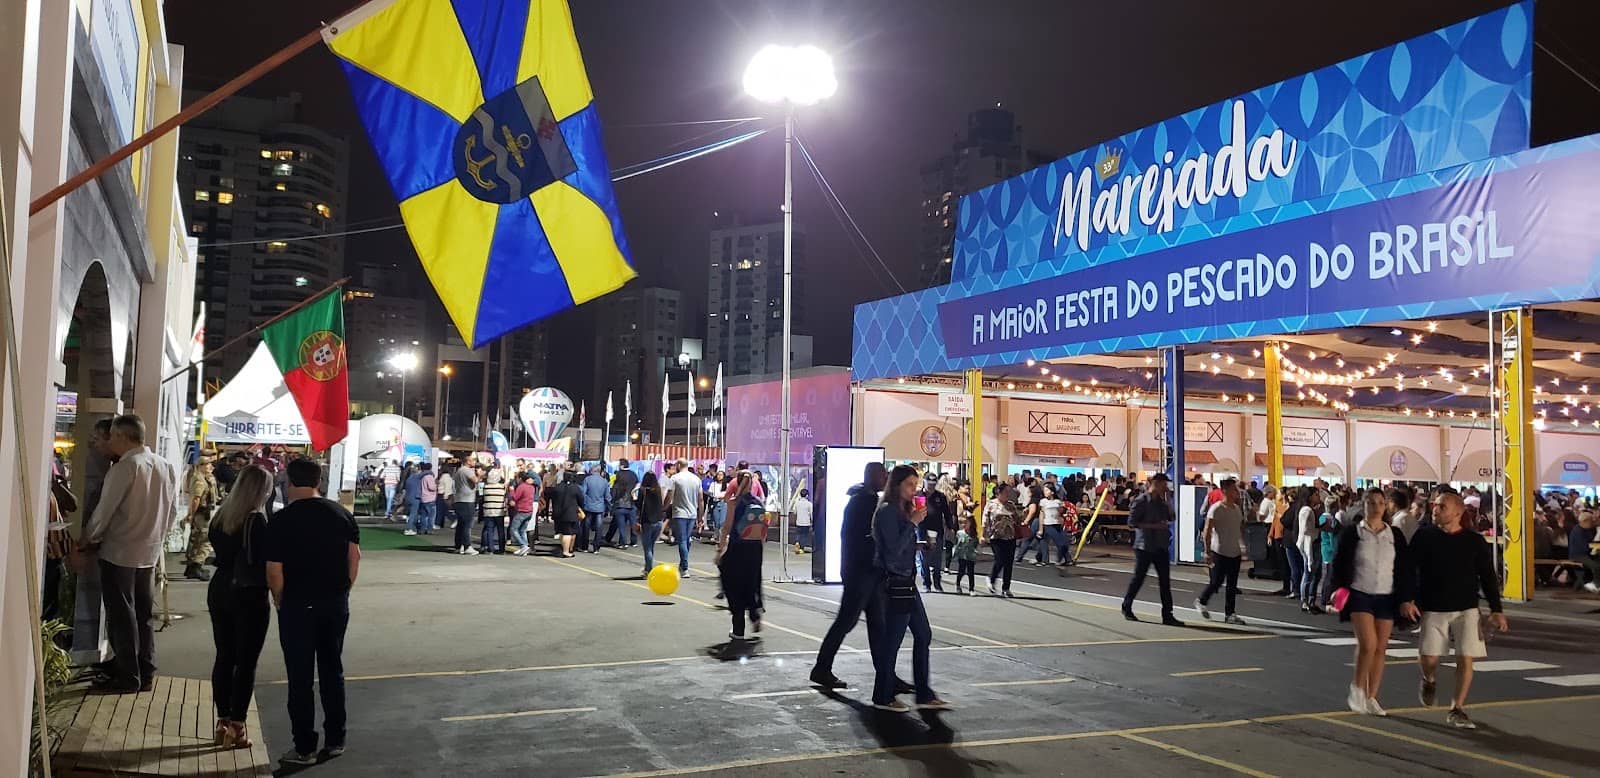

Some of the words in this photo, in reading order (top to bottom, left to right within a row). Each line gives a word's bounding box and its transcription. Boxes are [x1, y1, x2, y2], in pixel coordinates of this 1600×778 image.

[1053, 99, 1298, 252] Marejada
[972, 314, 985, 346] A
[1055, 286, 1118, 331] FESTA
[1126, 279, 1159, 319] DO
[1167, 253, 1297, 314] PESCADO
[1310, 242, 1355, 289] DO
[225, 422, 304, 436] HIDRATE-SE
[533, 403, 569, 411] NATIVA
